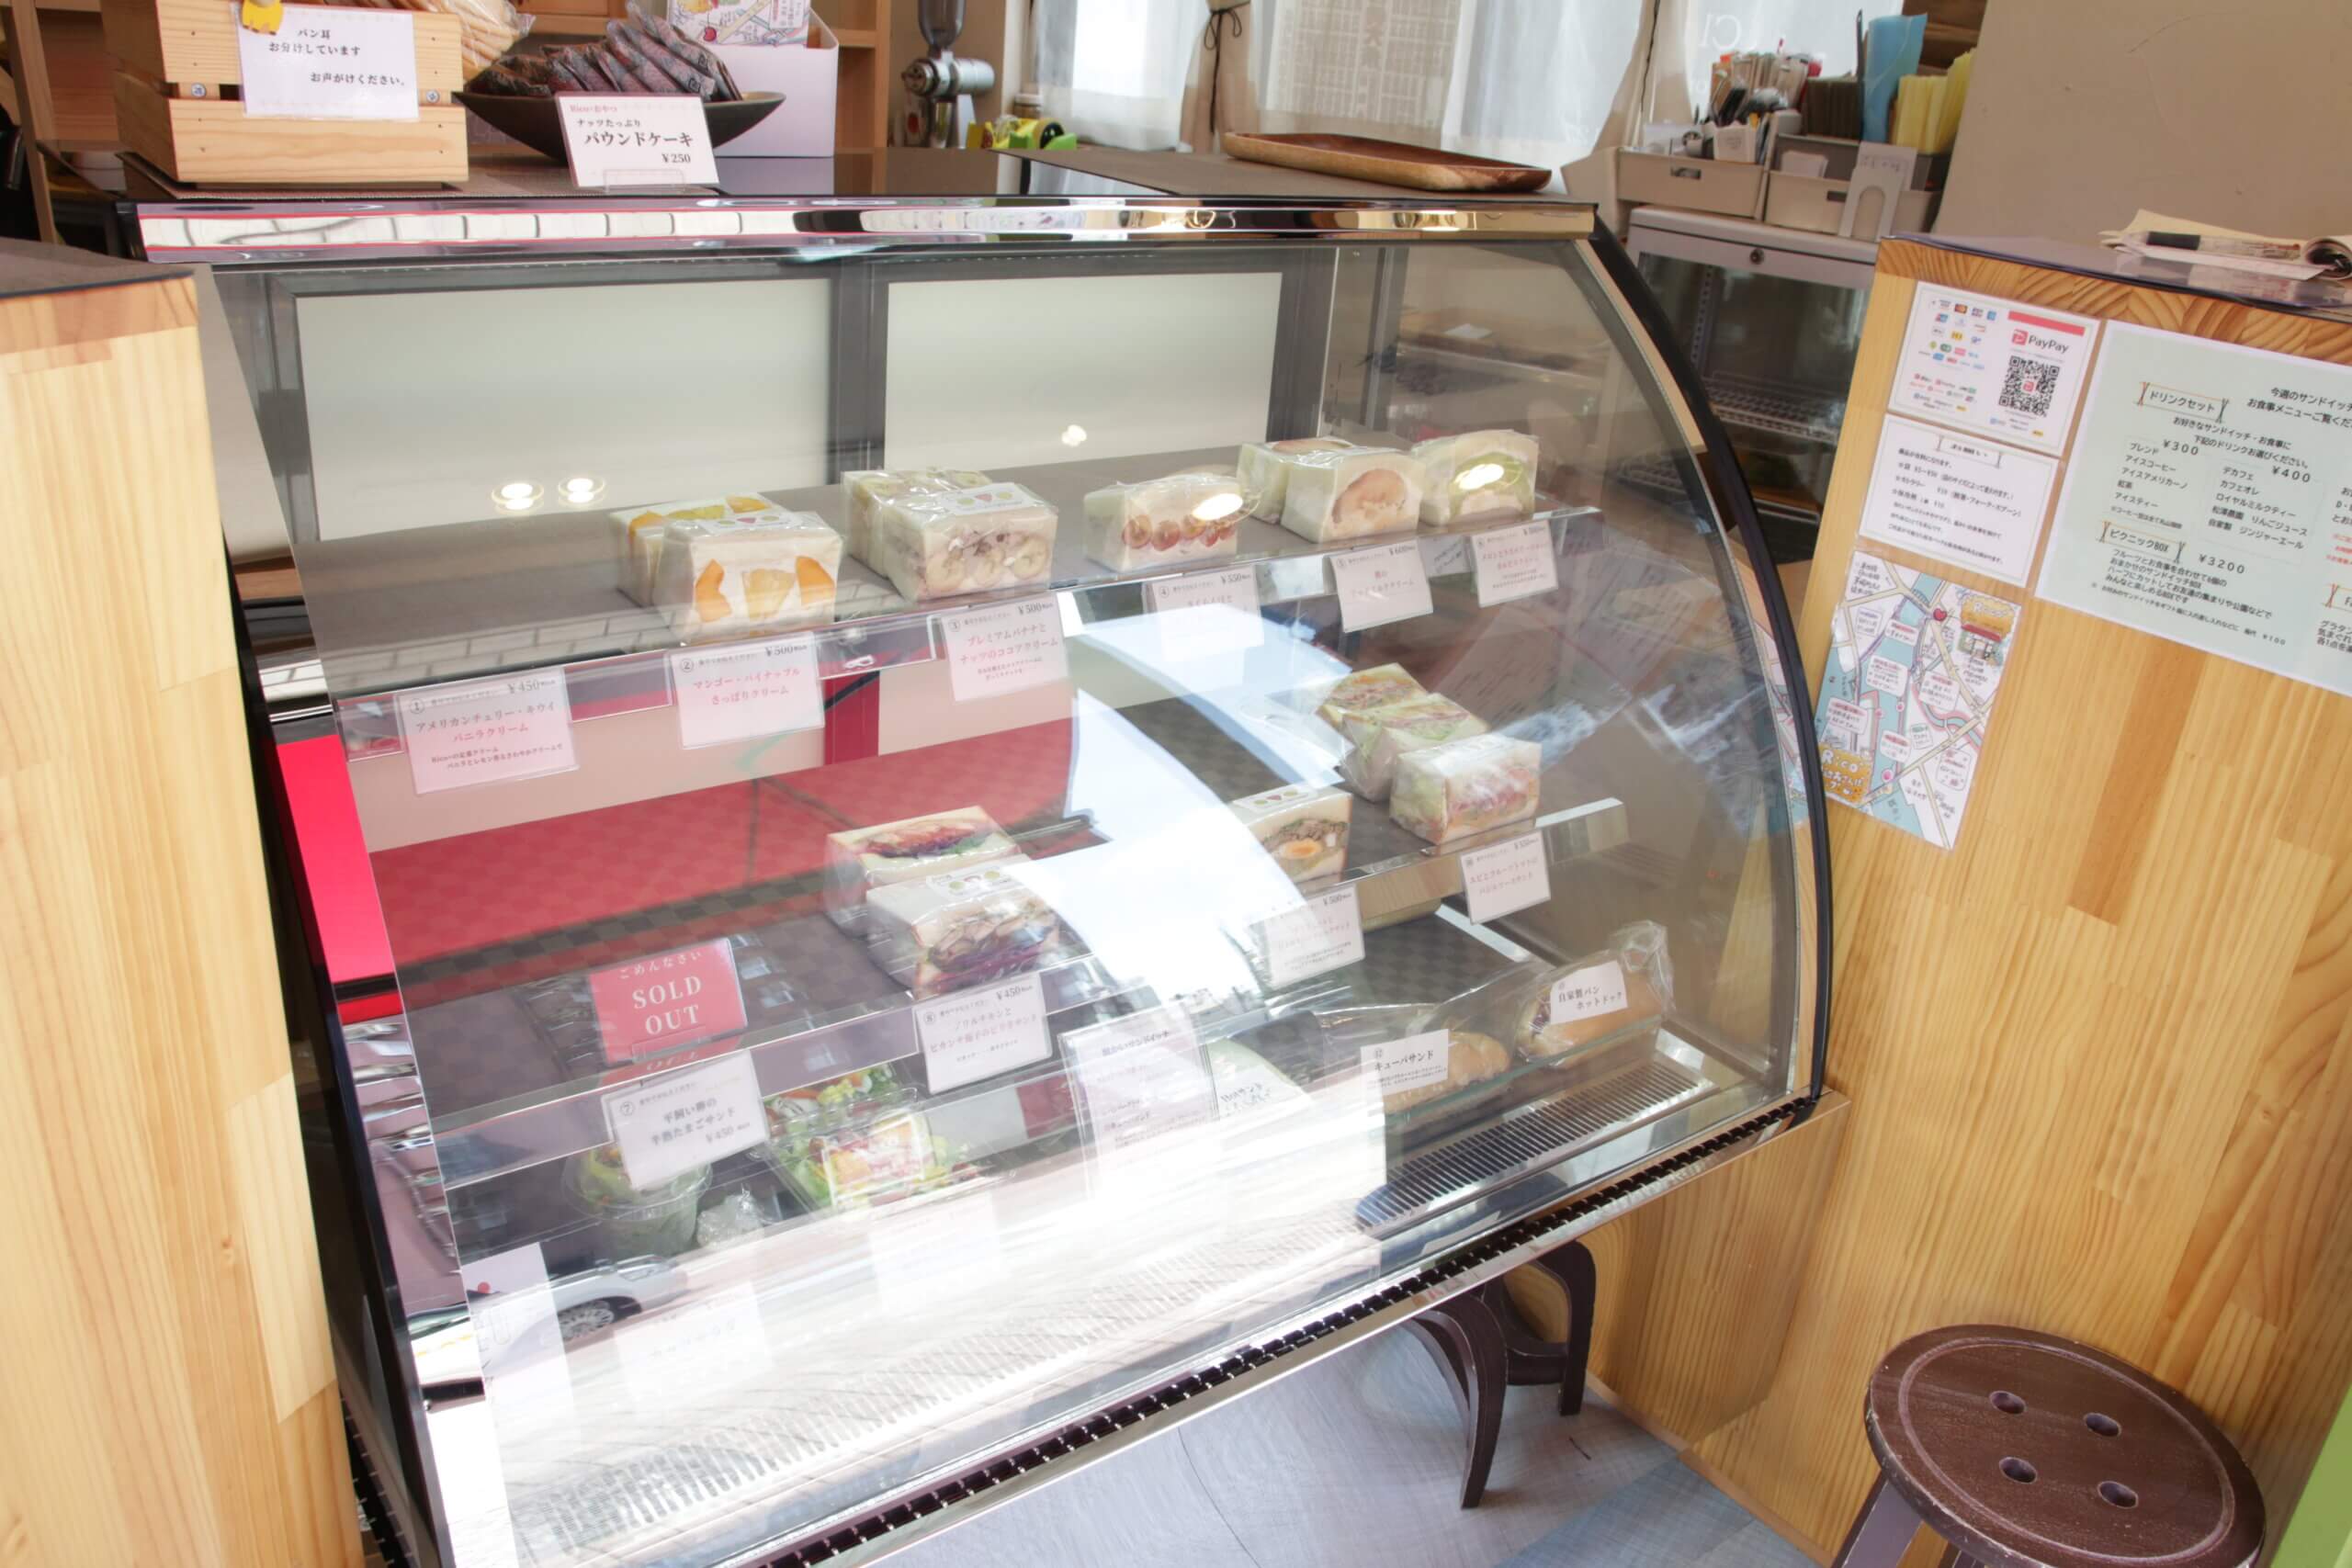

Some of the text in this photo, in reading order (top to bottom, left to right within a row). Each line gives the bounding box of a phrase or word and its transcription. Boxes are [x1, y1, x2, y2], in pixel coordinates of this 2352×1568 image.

[297, 28, 332, 39] パン耳
[269, 42, 361, 56] お分けしています
[577, 118, 641, 128] ナッツたっぷり
[584, 131, 694, 147] パウンドケーキ
[662, 153, 692, 164] ¥250
[2028, 334, 2070, 355] PayPay
[2149, 389, 2216, 412] ドリンクセット
[2247, 398, 2352, 429] お食事メニューご覧くだ
[2131, 442, 2159, 456] ブレンド
[2164, 439, 2199, 456] ¥300
[2125, 455, 2176, 472] アイスコーヒー
[2121, 467, 2188, 490] アイスアメリカーノ
[2222, 467, 2254, 481] デカフェ
[2272, 466, 2311, 483] ¥400
[2220, 480, 2259, 495] カフェオレ
[2115, 491, 2159, 507] アイスティー
[2216, 492, 2297, 517] ロイヤルミルクティー
[2252, 515, 2308, 536] りんごジュース
[2240, 526, 2304, 549] ジンジャーエール
[2199, 554, 2245, 574] ¥3200
[764, 646, 793, 657] ¥500
[507, 680, 540, 694] ¥450
[711, 686, 788, 705] さっぱりクリーム
[453, 723, 529, 742] バニラクリーム
[632, 976, 701, 1010] SOLD
[646, 1004, 698, 1034] OUT
